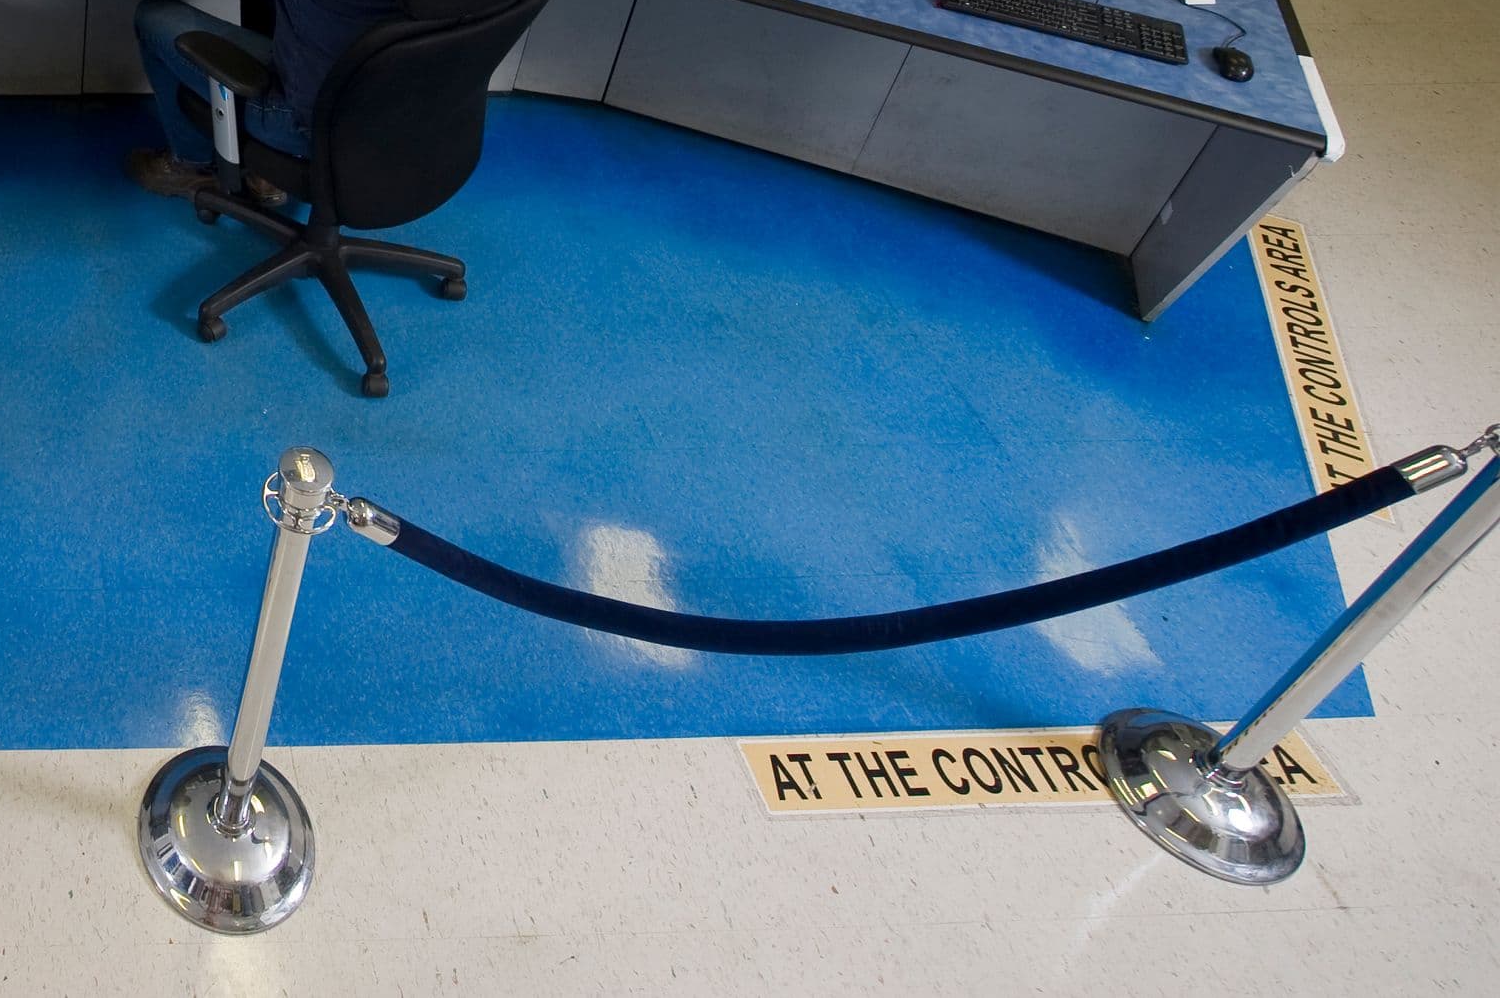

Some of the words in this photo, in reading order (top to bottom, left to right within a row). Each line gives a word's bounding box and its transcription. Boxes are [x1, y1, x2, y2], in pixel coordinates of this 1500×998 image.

[1259, 224, 1311, 282] AREA
[1274, 280, 1348, 407] CONTROLS
[1309, 406, 1365, 462] THE
[768, 753, 824, 801] AT
[826, 750, 930, 799] THE
[931, 744, 1110, 795] CONTRO
